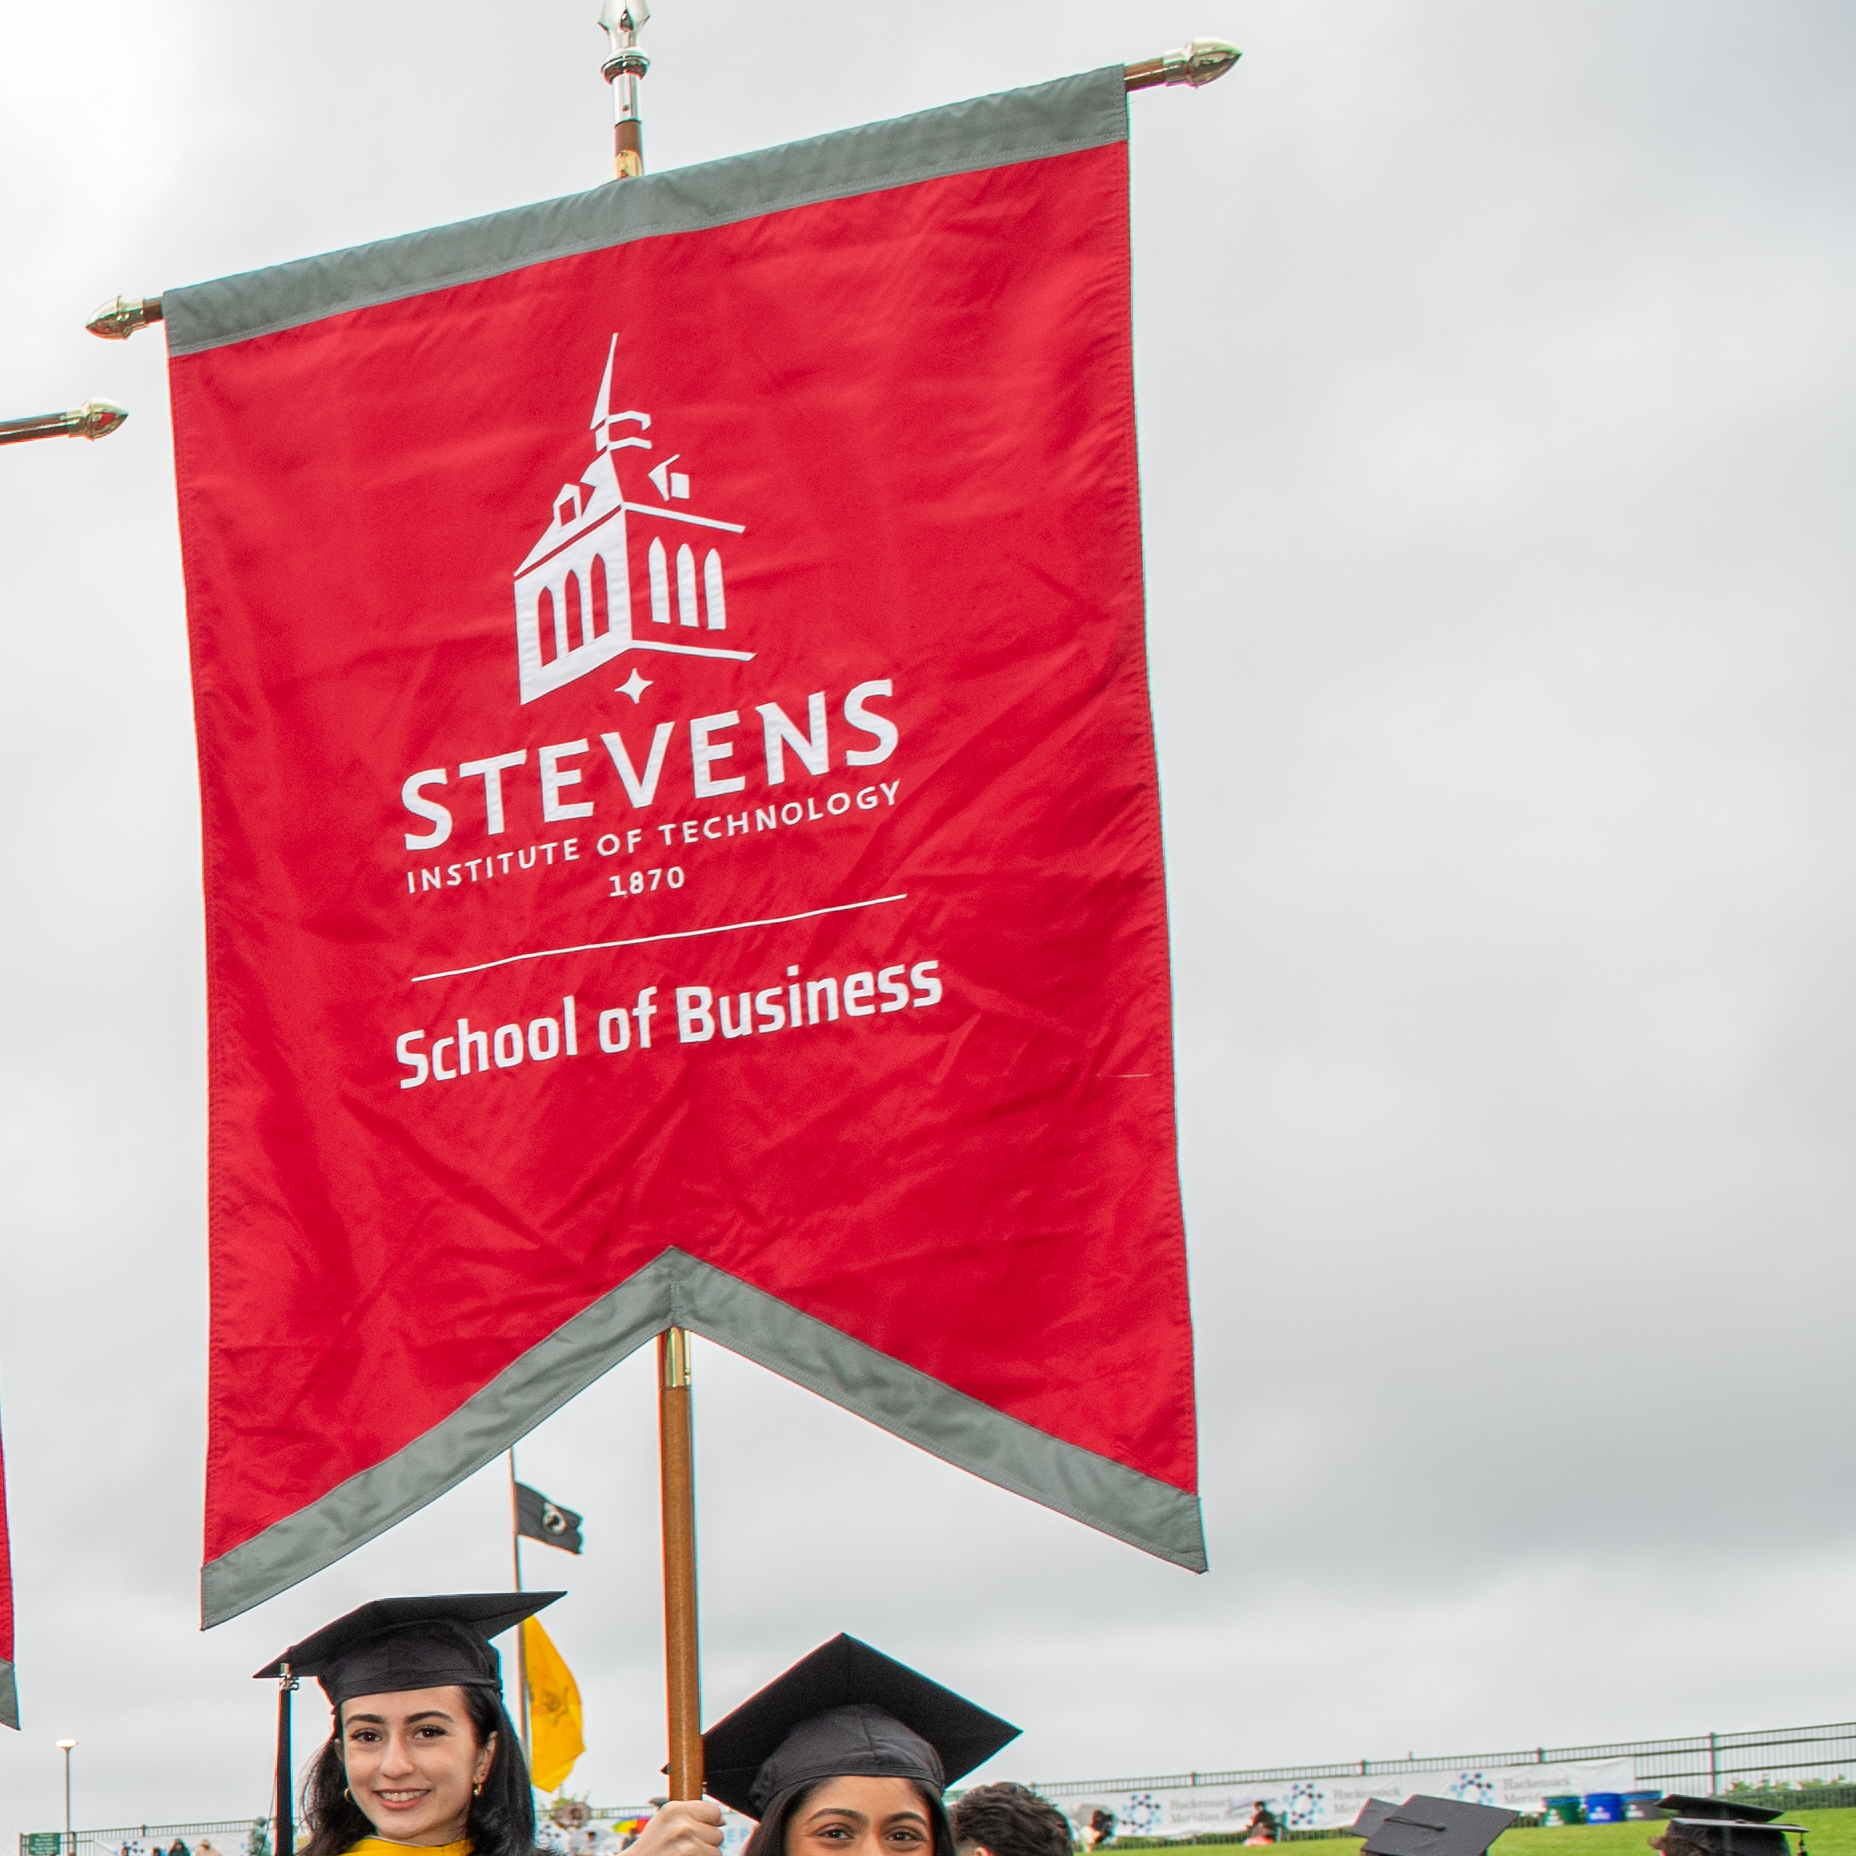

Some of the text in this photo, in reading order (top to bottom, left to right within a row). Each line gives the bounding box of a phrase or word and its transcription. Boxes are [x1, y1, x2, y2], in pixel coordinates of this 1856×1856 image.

[402, 679, 898, 850] STEVENS
[408, 781, 899, 893] INSTITUTE OF TECHNOLOGY
[610, 867, 684, 896] 1870
[397, 961, 942, 1088] School of Business
